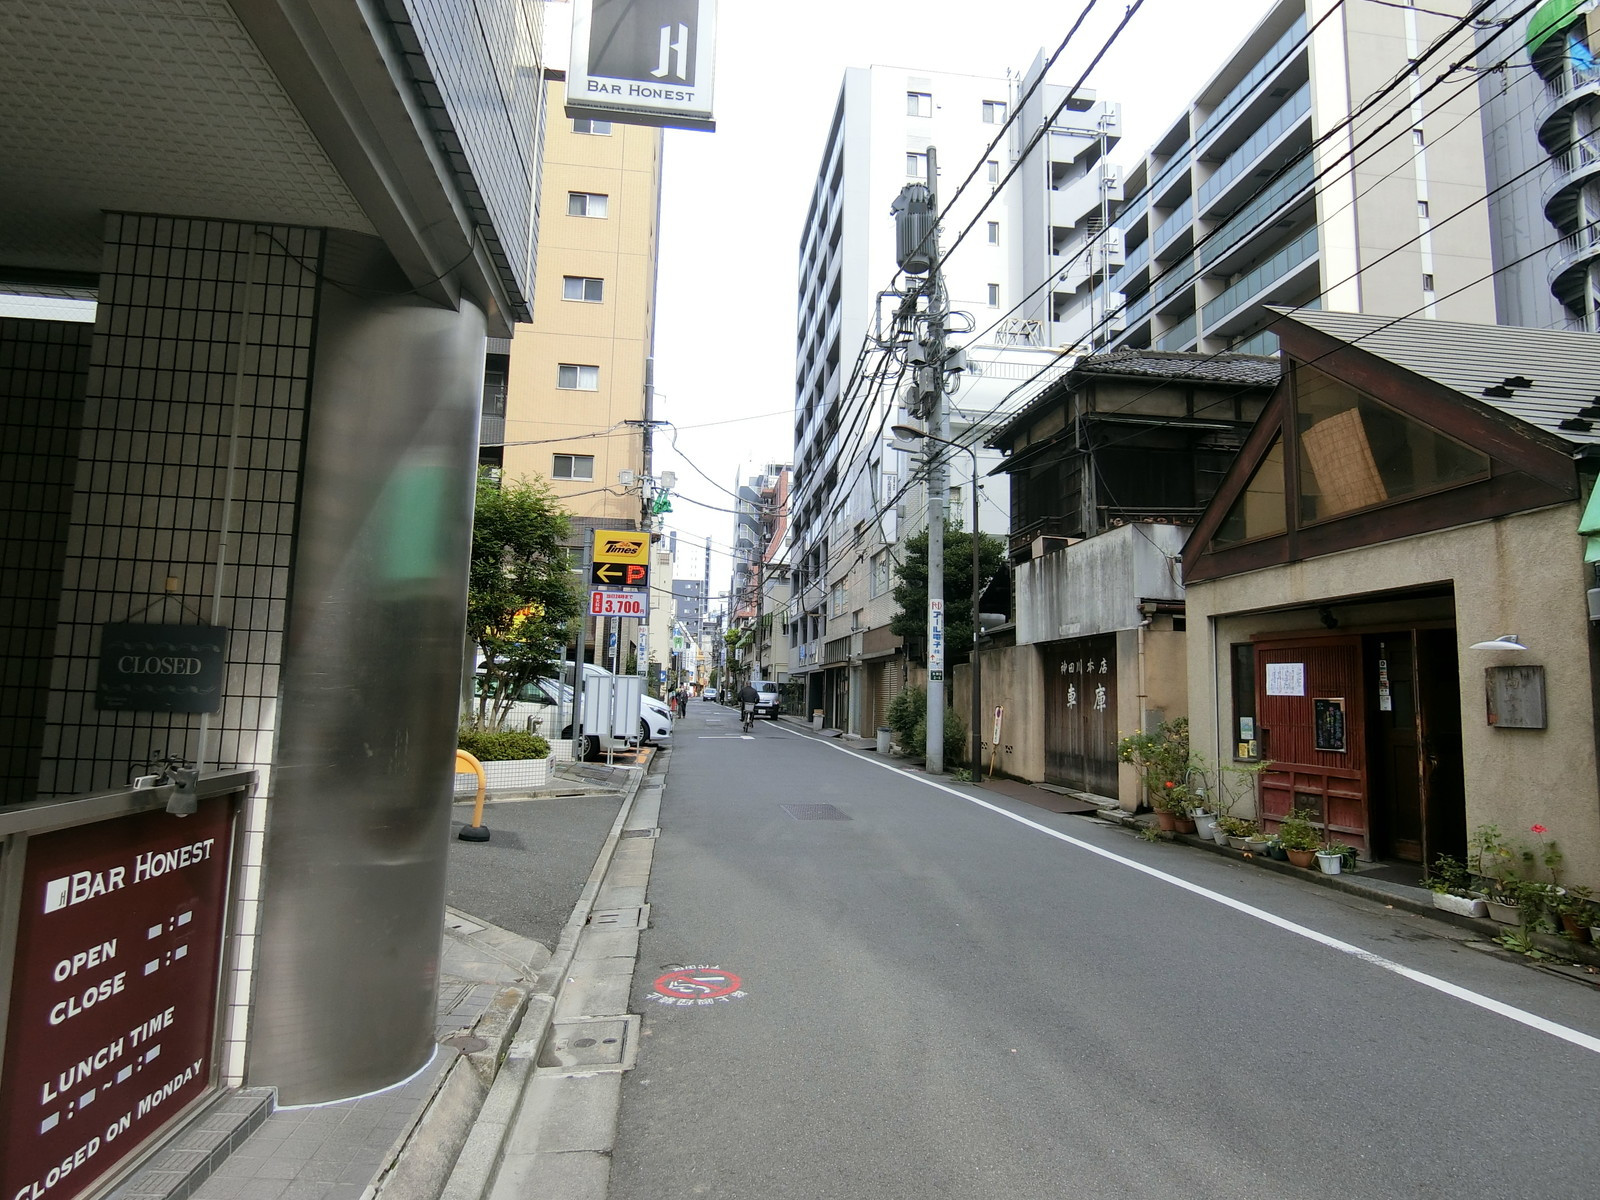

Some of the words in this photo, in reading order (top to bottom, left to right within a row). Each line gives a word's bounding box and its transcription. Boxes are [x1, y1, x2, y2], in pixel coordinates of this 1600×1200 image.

[587, 80, 622, 95] BAR
[629, 84, 695, 102] HONEST
[605, 541, 640, 554] Times
[626, 565, 645, 584] P
[118, 655, 202, 675] CLOSED
[68, 870, 125, 906] BAR
[133, 838, 215, 884] HONEST
[54, 939, 118, 982] OPEN
[50, 971, 126, 1025] CLOSE
[42, 1037, 124, 1105] LUNCH
[129, 1005, 175, 1048] TIME
[106, 1111, 132, 1142] ON
[136, 1058, 203, 1120] MONDAY
